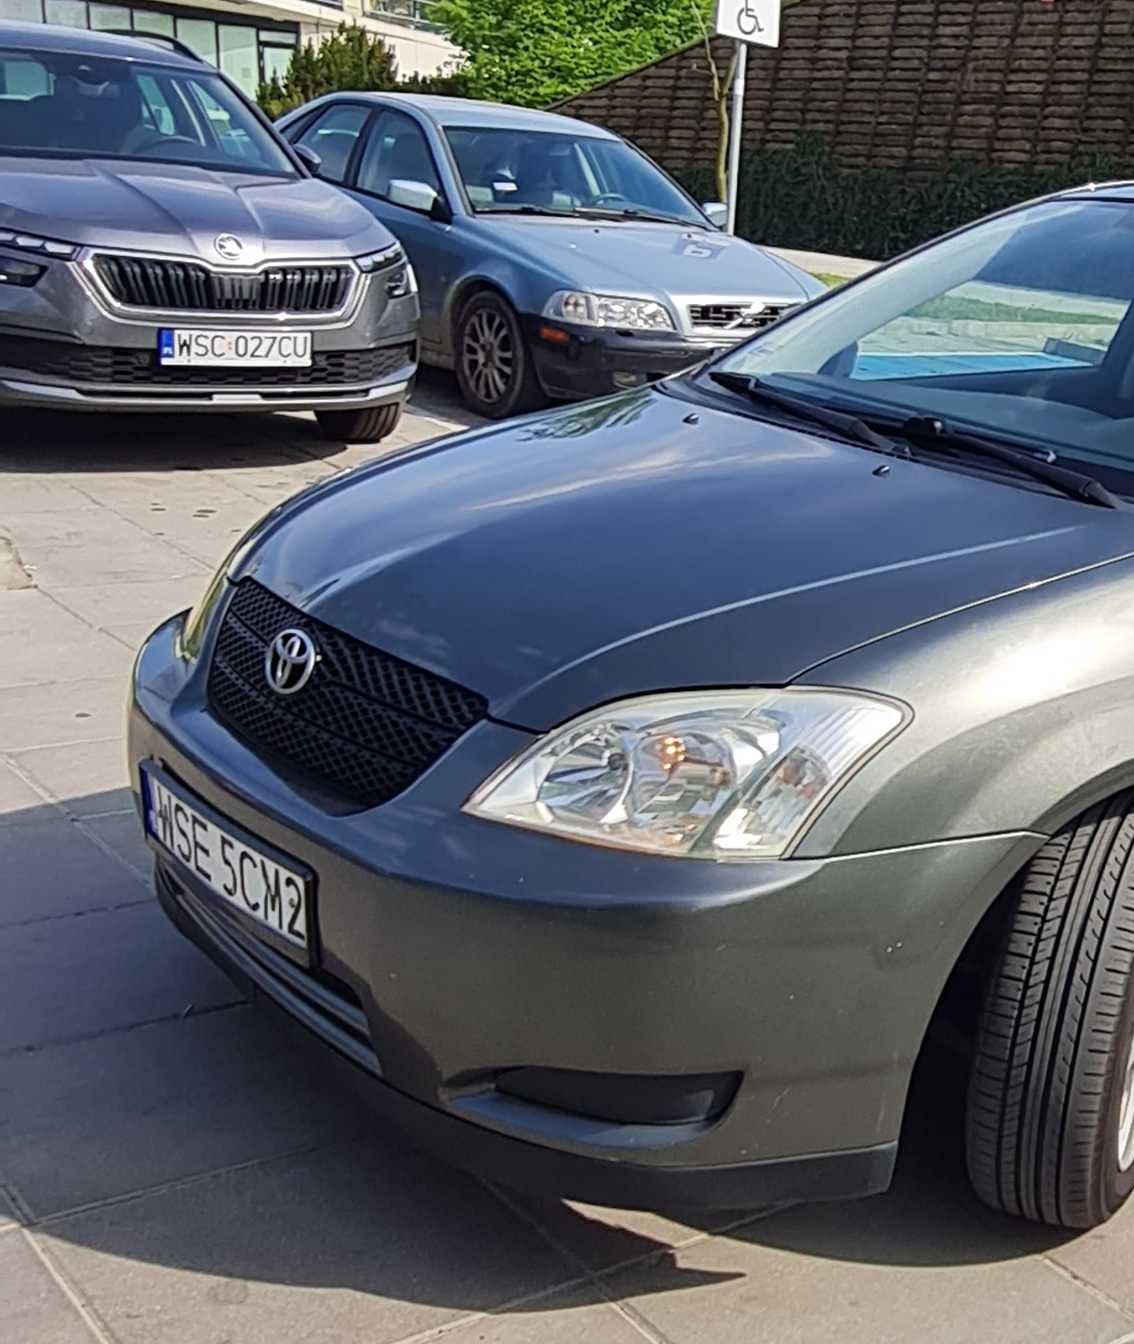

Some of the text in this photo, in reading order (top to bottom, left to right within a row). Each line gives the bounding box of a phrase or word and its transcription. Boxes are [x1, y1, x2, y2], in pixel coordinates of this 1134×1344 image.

[177, 333, 308, 358] WSC 027CU
[156, 785, 306, 941] WSE 5CM2
